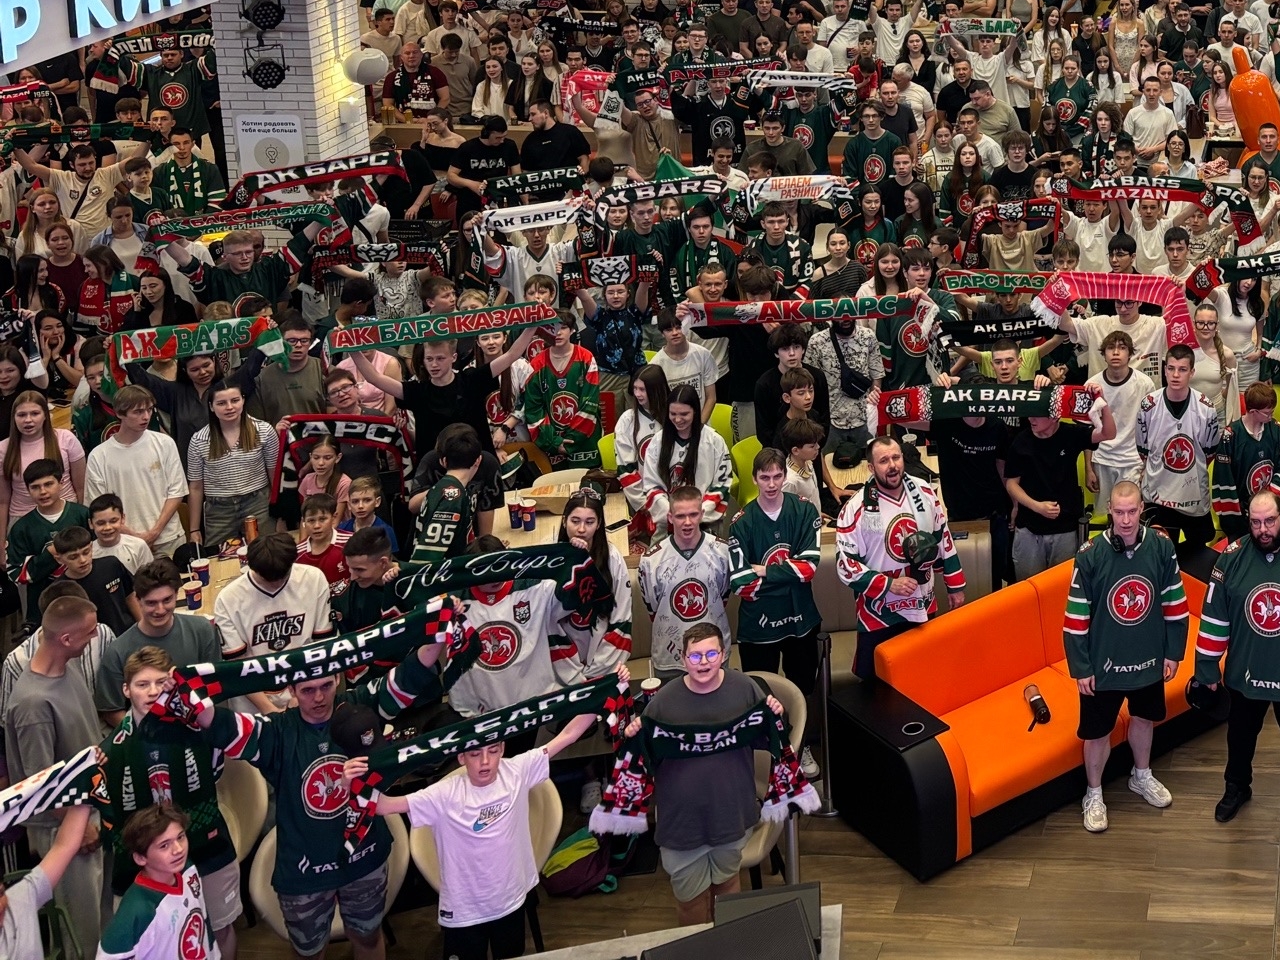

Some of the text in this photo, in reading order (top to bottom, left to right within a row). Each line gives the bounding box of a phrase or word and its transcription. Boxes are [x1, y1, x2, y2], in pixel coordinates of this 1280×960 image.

[984, 20, 1018, 33] БАРС
[627, 72, 643, 82] АК
[670, 60, 784, 82] АК БАРС
[768, 73, 830, 82] АК БАРС
[263, 120, 296, 128] радовать
[257, 151, 391, 188] АК БАРС
[496, 168, 578, 189] АК БАРС
[515, 182, 563, 193] КАЗАНЬ
[613, 179, 657, 191] HOCKEY
[635, 179, 722, 201] BARS
[770, 177, 811, 191] ДЕЛАЕМ
[1122, 175, 1181, 189] BARS
[780, 186, 824, 201] РАЗНИЦУ
[1101, 189, 1169, 200] KAZAN
[158, 203, 331, 235] АК БАРС КАЗАНЬ
[491, 209, 567, 228] АК БАРС
[1236, 254, 1267, 268] АК
[945, 272, 999, 290] БАРС
[757, 296, 898, 322] АК БАРС
[336, 305, 557, 348] АК БАРС КАЗАНЬ
[973, 318, 1046, 333] АК БАРС
[121, 318, 252, 360] AK BARS
[943, 388, 1042, 402] AK BARS
[968, 404, 1016, 413] KAZAN
[1160, 499, 1202, 508] TATNEFT
[426, 523, 455, 545] 95
[729, 553, 744, 572] 17
[836, 557, 864, 578] 39
[255, 613, 304, 644] KINGS
[240, 617, 406, 679] АК БАРС
[274, 649, 374, 686] КАЗАНЬ
[1113, 657, 1157, 673] TATNEFT
[397, 684, 596, 765] АК БАРС
[652, 710, 764, 743] AK BARS
[443, 713, 554, 757] КАЗАНЬ
[679, 734, 738, 752] KAZAN
